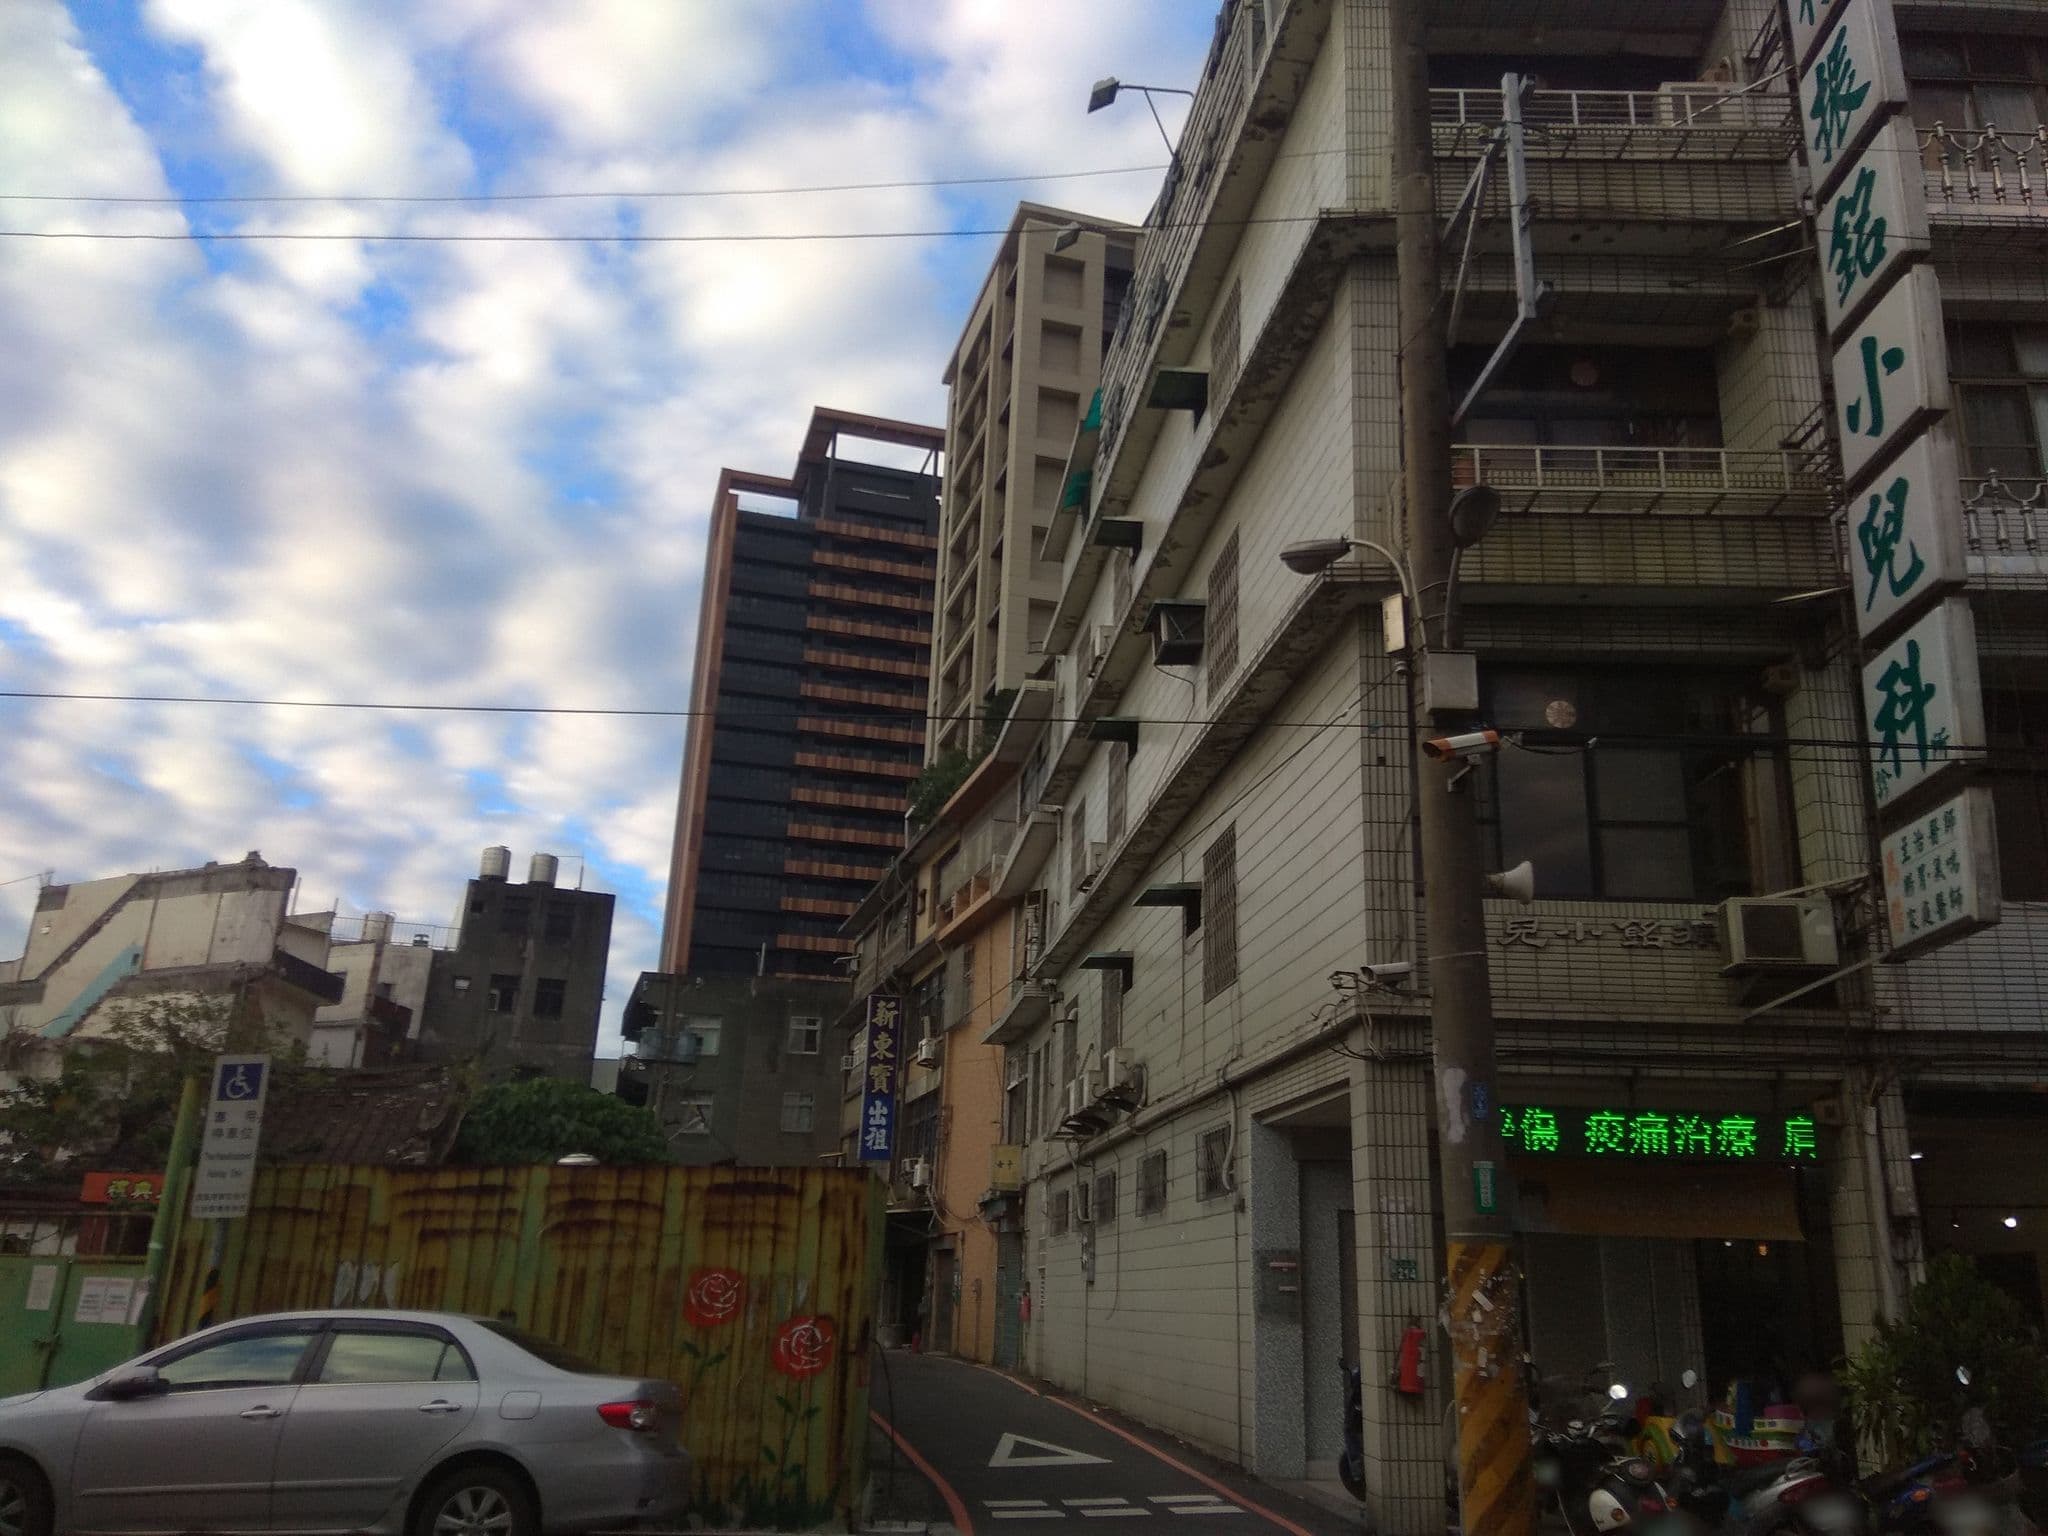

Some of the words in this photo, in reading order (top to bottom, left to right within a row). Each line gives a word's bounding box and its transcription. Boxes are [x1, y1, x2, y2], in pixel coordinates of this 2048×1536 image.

[1797, 0, 1937, 779] 振銘小兒科
[865, 1100, 890, 1150] 出租
